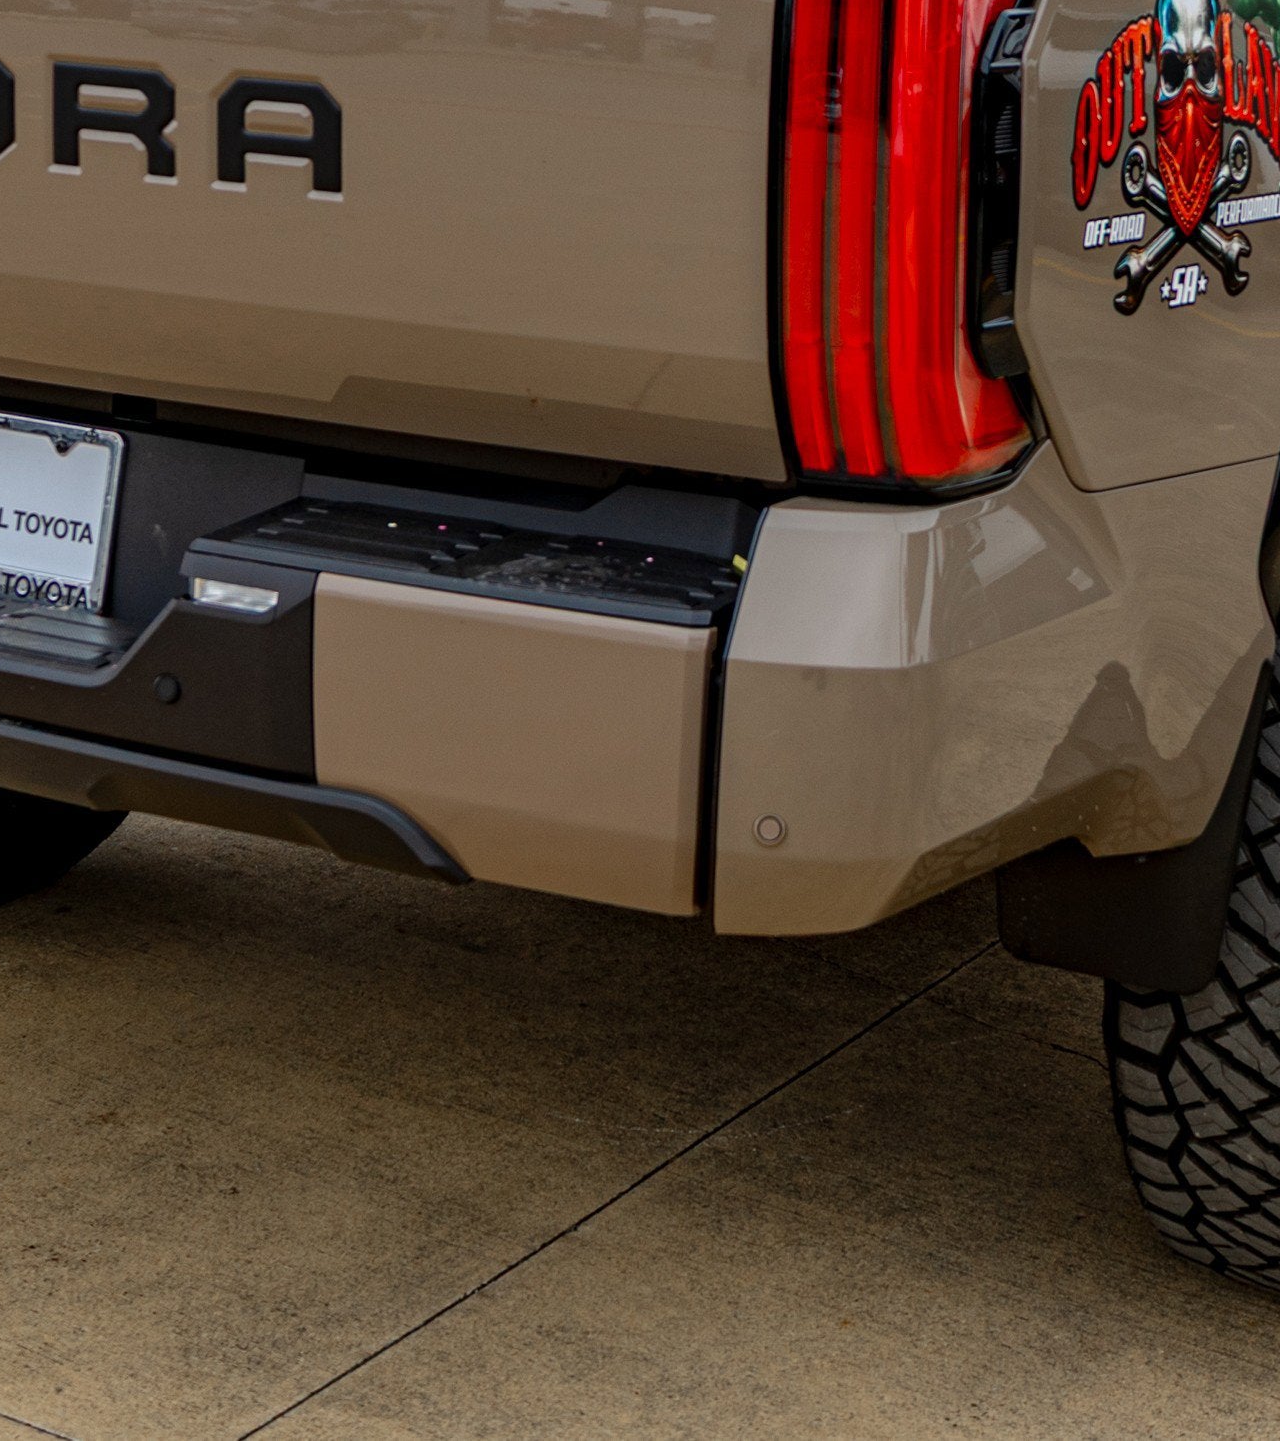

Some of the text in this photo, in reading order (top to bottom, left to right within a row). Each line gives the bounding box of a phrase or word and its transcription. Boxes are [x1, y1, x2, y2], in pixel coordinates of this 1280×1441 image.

[1084, 213, 1145, 248] OFF-ROAD
[1168, 265, 1201, 307] SA
[13, 510, 94, 545] TOYOTA
[2, 572, 89, 608] TOYOTA
